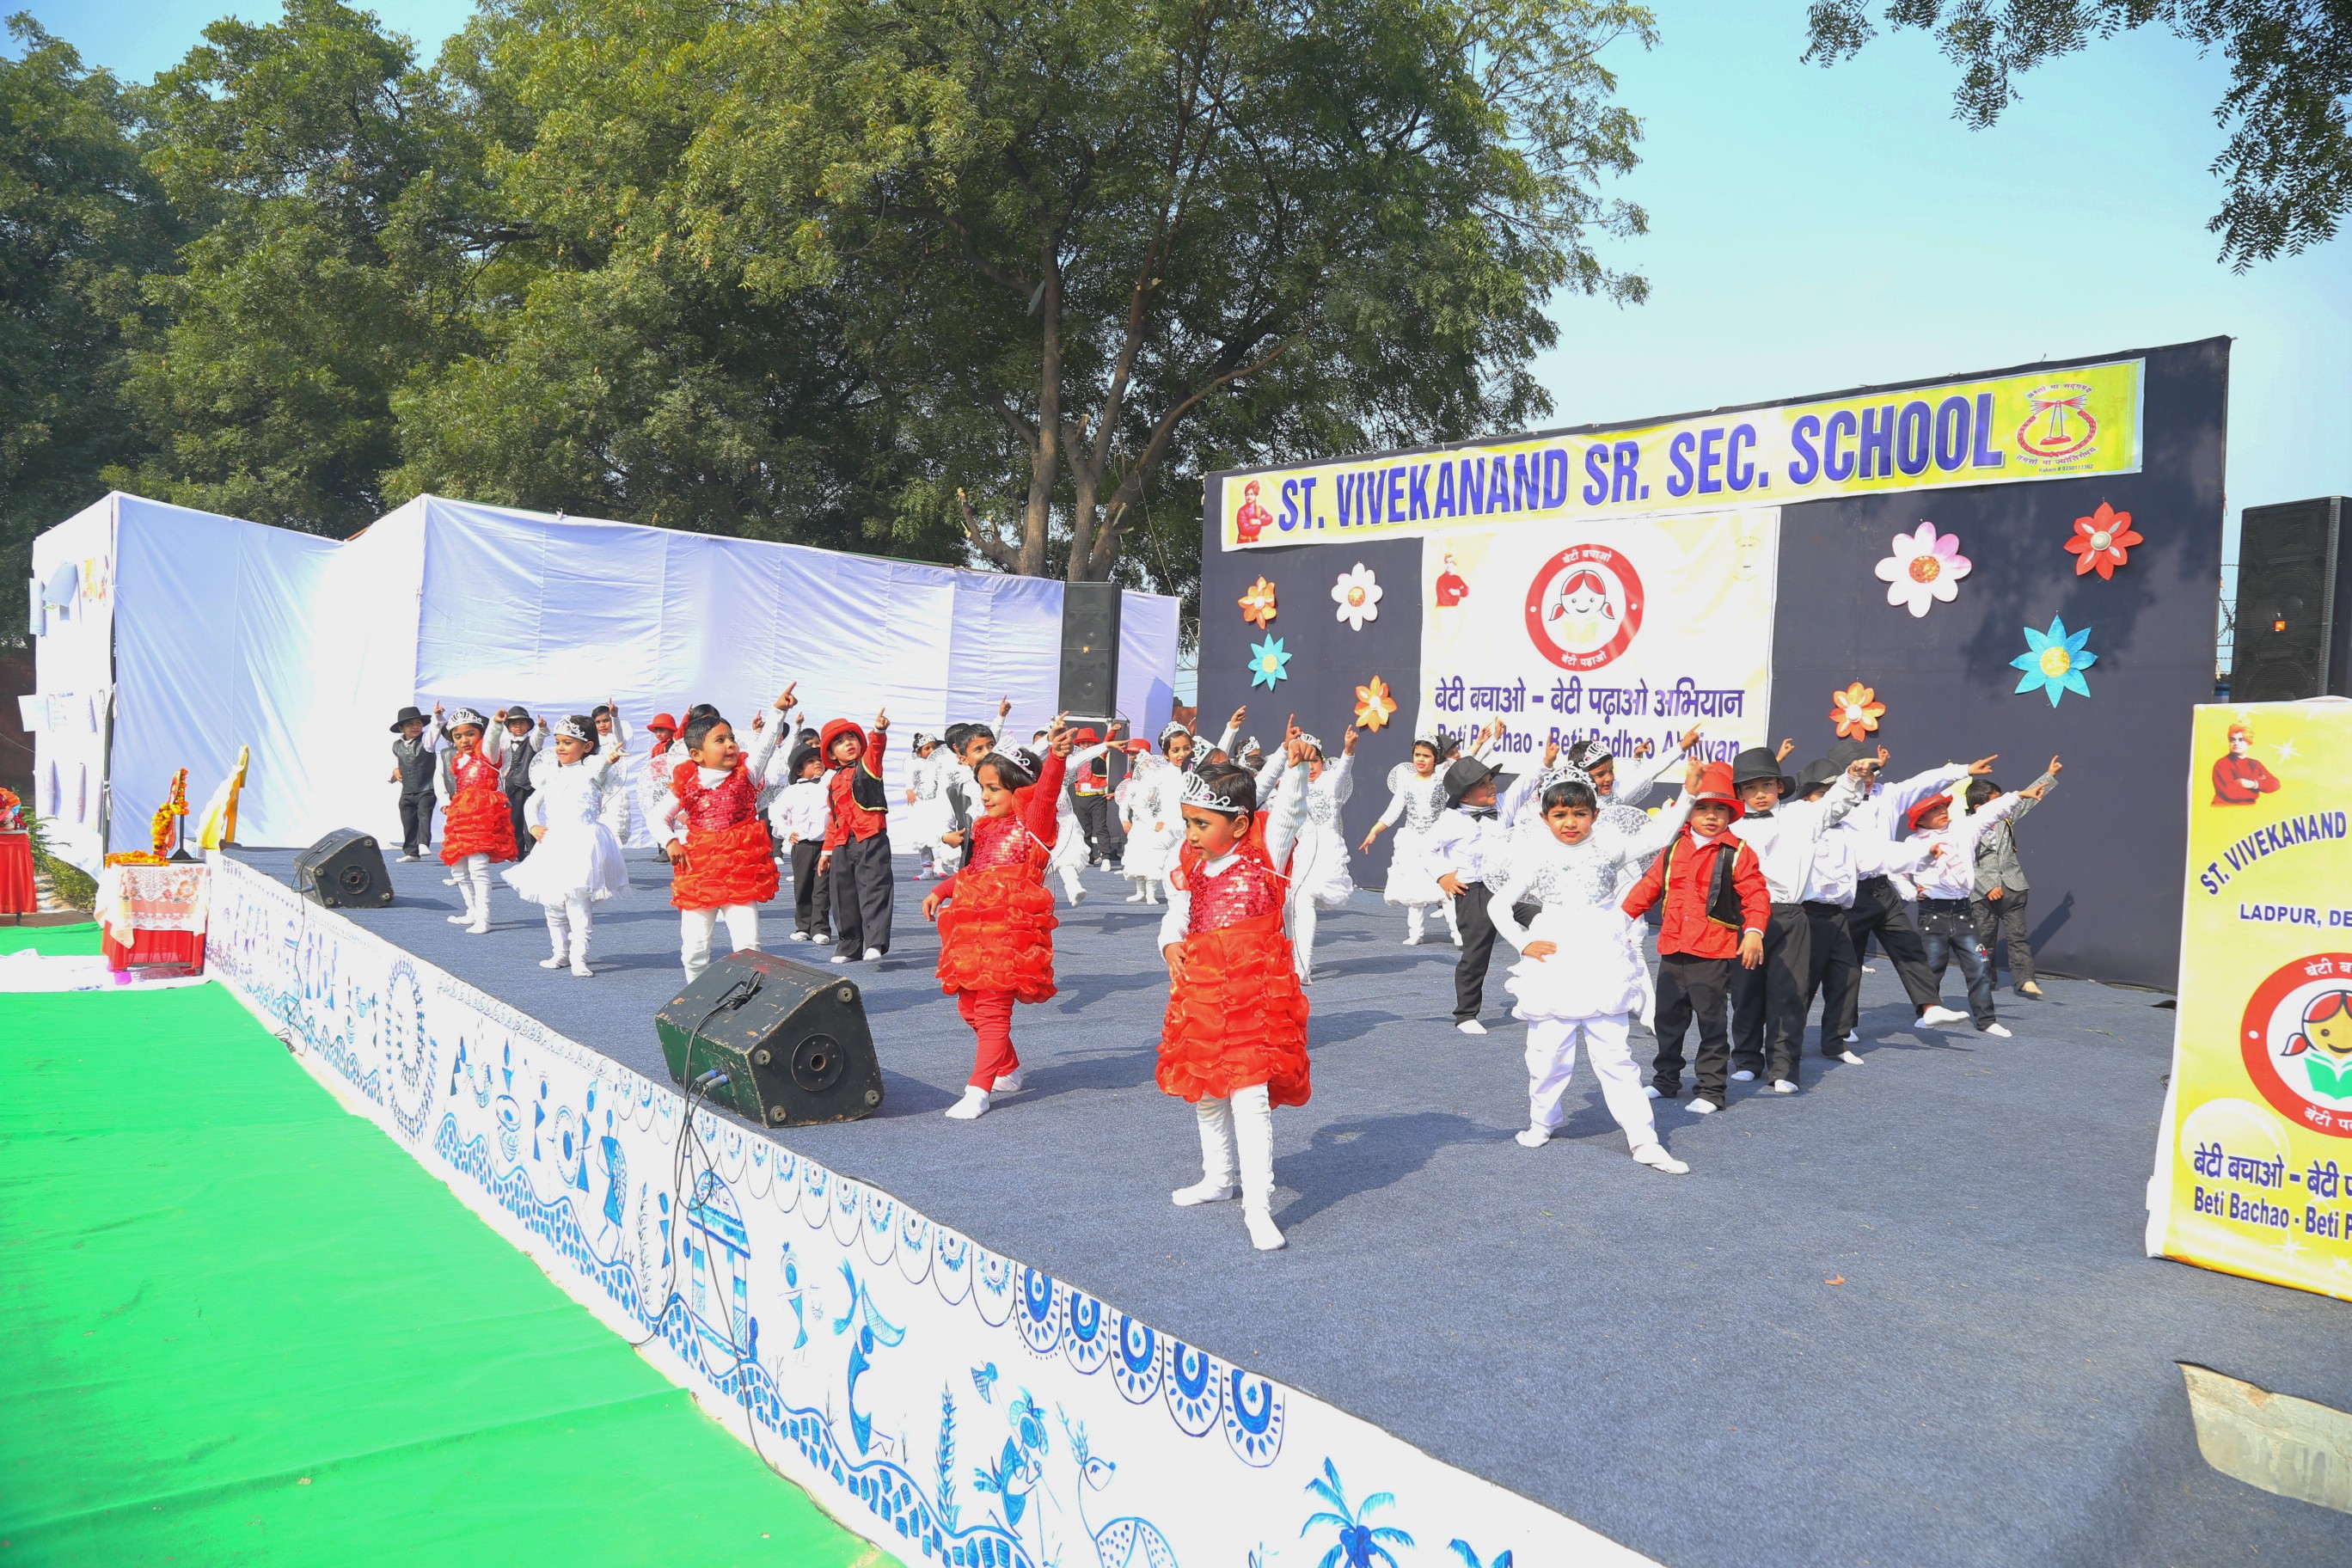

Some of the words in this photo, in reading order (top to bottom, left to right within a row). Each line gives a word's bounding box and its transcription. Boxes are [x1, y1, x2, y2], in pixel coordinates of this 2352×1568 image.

[1278, 476, 1325, 531] ST.
[1336, 448, 1569, 528] VIVEKANAND
[1582, 440, 1651, 506] SR.
[1666, 423, 1769, 498] SEC.
[1788, 393, 2005, 485] SCHOOL
[1562, 548, 1579, 563] बेटी
[1560, 652, 1577, 666] बेटी
[1435, 675, 1466, 713] बेटी
[1469, 676, 1527, 713] बचाओ
[1550, 675, 1583, 715] बेटी
[1653, 676, 1745, 718] अभियान
[2200, 861, 2230, 896] ST.
[2223, 811, 2348, 872] VIVEKANAND
[2239, 903, 2322, 928] LADPUR,
[2304, 957, 2334, 977] बेटी
[2304, 1105, 2333, 1128] बेटी
[2194, 1141, 2224, 1179] बेटी
[2227, 1153, 2285, 1189] बचाओ
[2306, 1159, 2340, 1198] बेटी
[2194, 1185, 2225, 1216] Beti
[2229, 1191, 2290, 1228] Bachao
[2305, 1205, 2340, 1239] Beti
